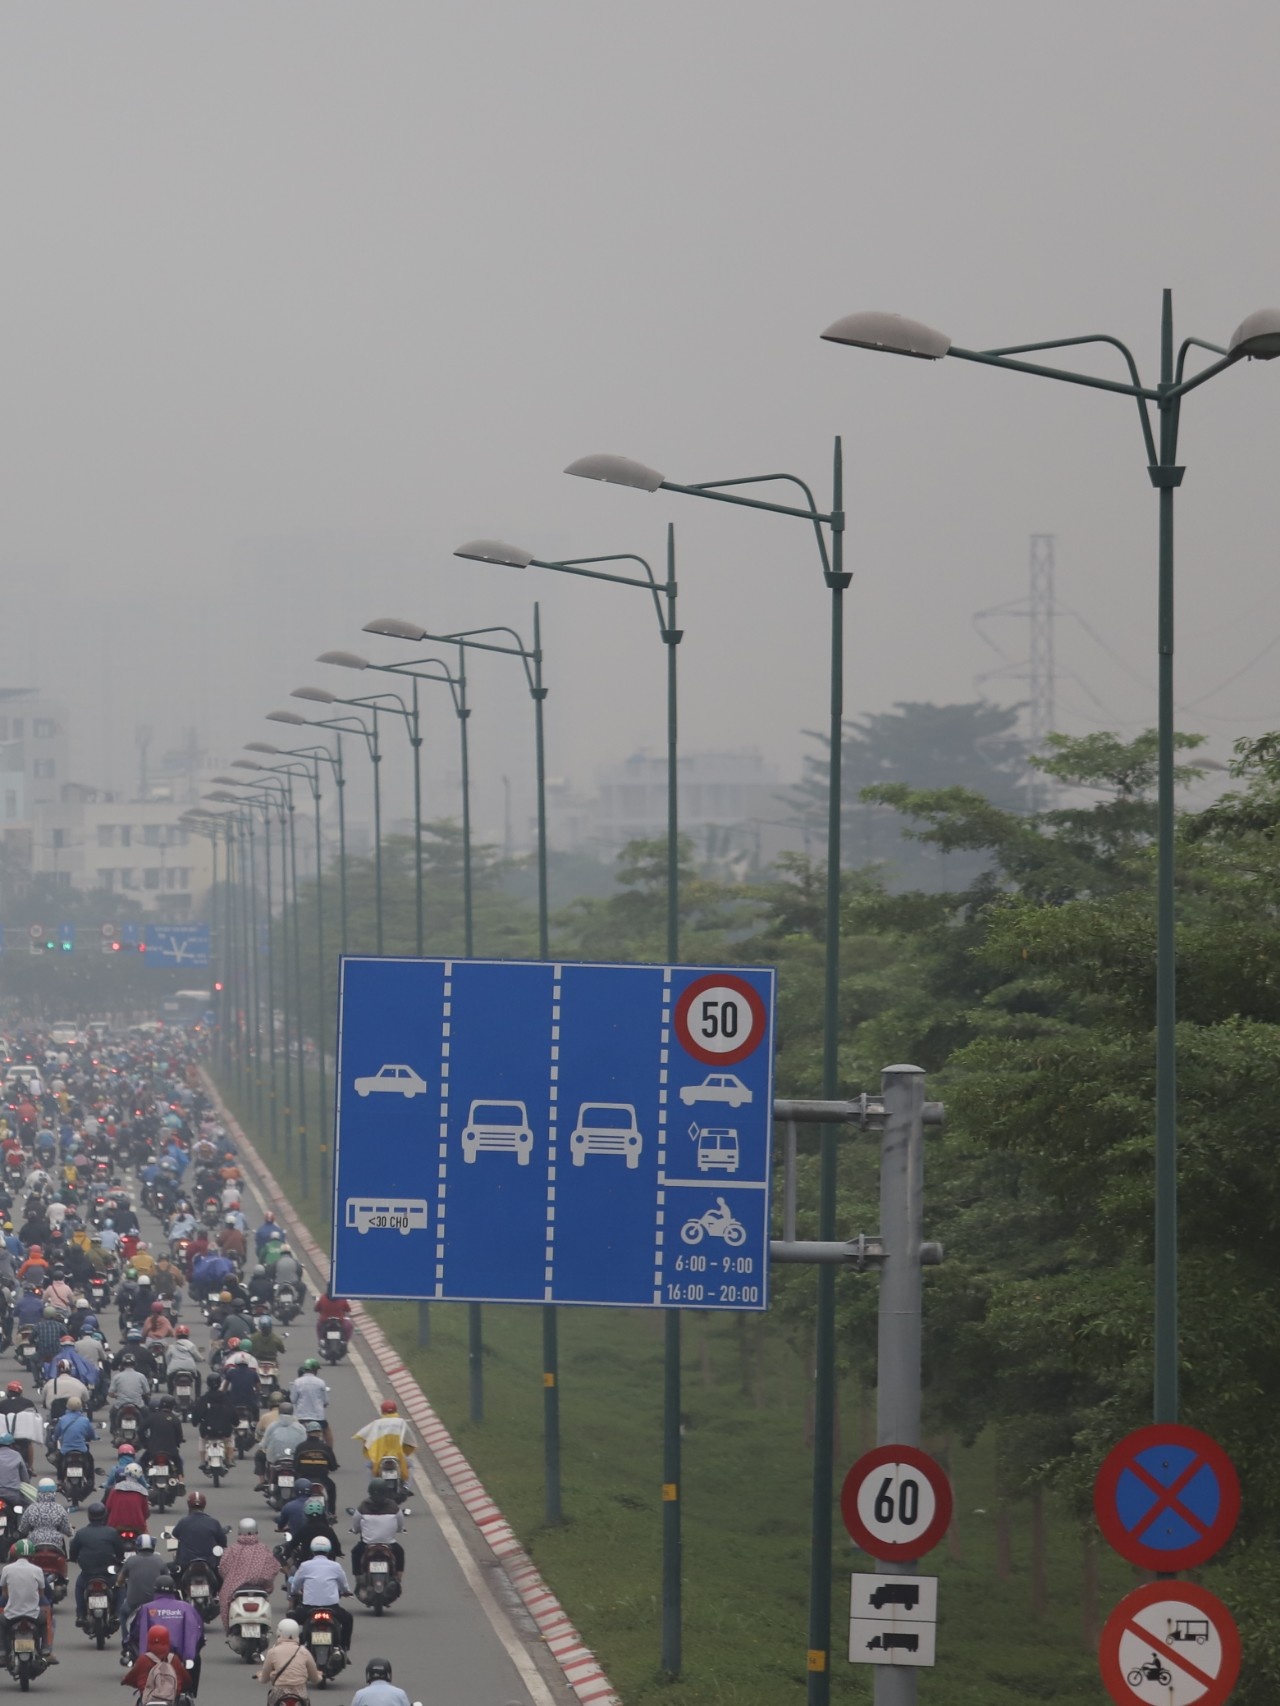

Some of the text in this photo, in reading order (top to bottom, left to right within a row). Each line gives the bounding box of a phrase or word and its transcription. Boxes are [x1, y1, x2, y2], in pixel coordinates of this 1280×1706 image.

[702, 1001, 738, 1039] 50
[675, 1255, 706, 1272] 6:00
[722, 1256, 753, 1274] 9:00
[667, 1283, 704, 1301] 16:00
[720, 1285, 758, 1303] 20:00
[874, 1477, 919, 1526] 60
[157, 1609, 182, 1617] TPBank
